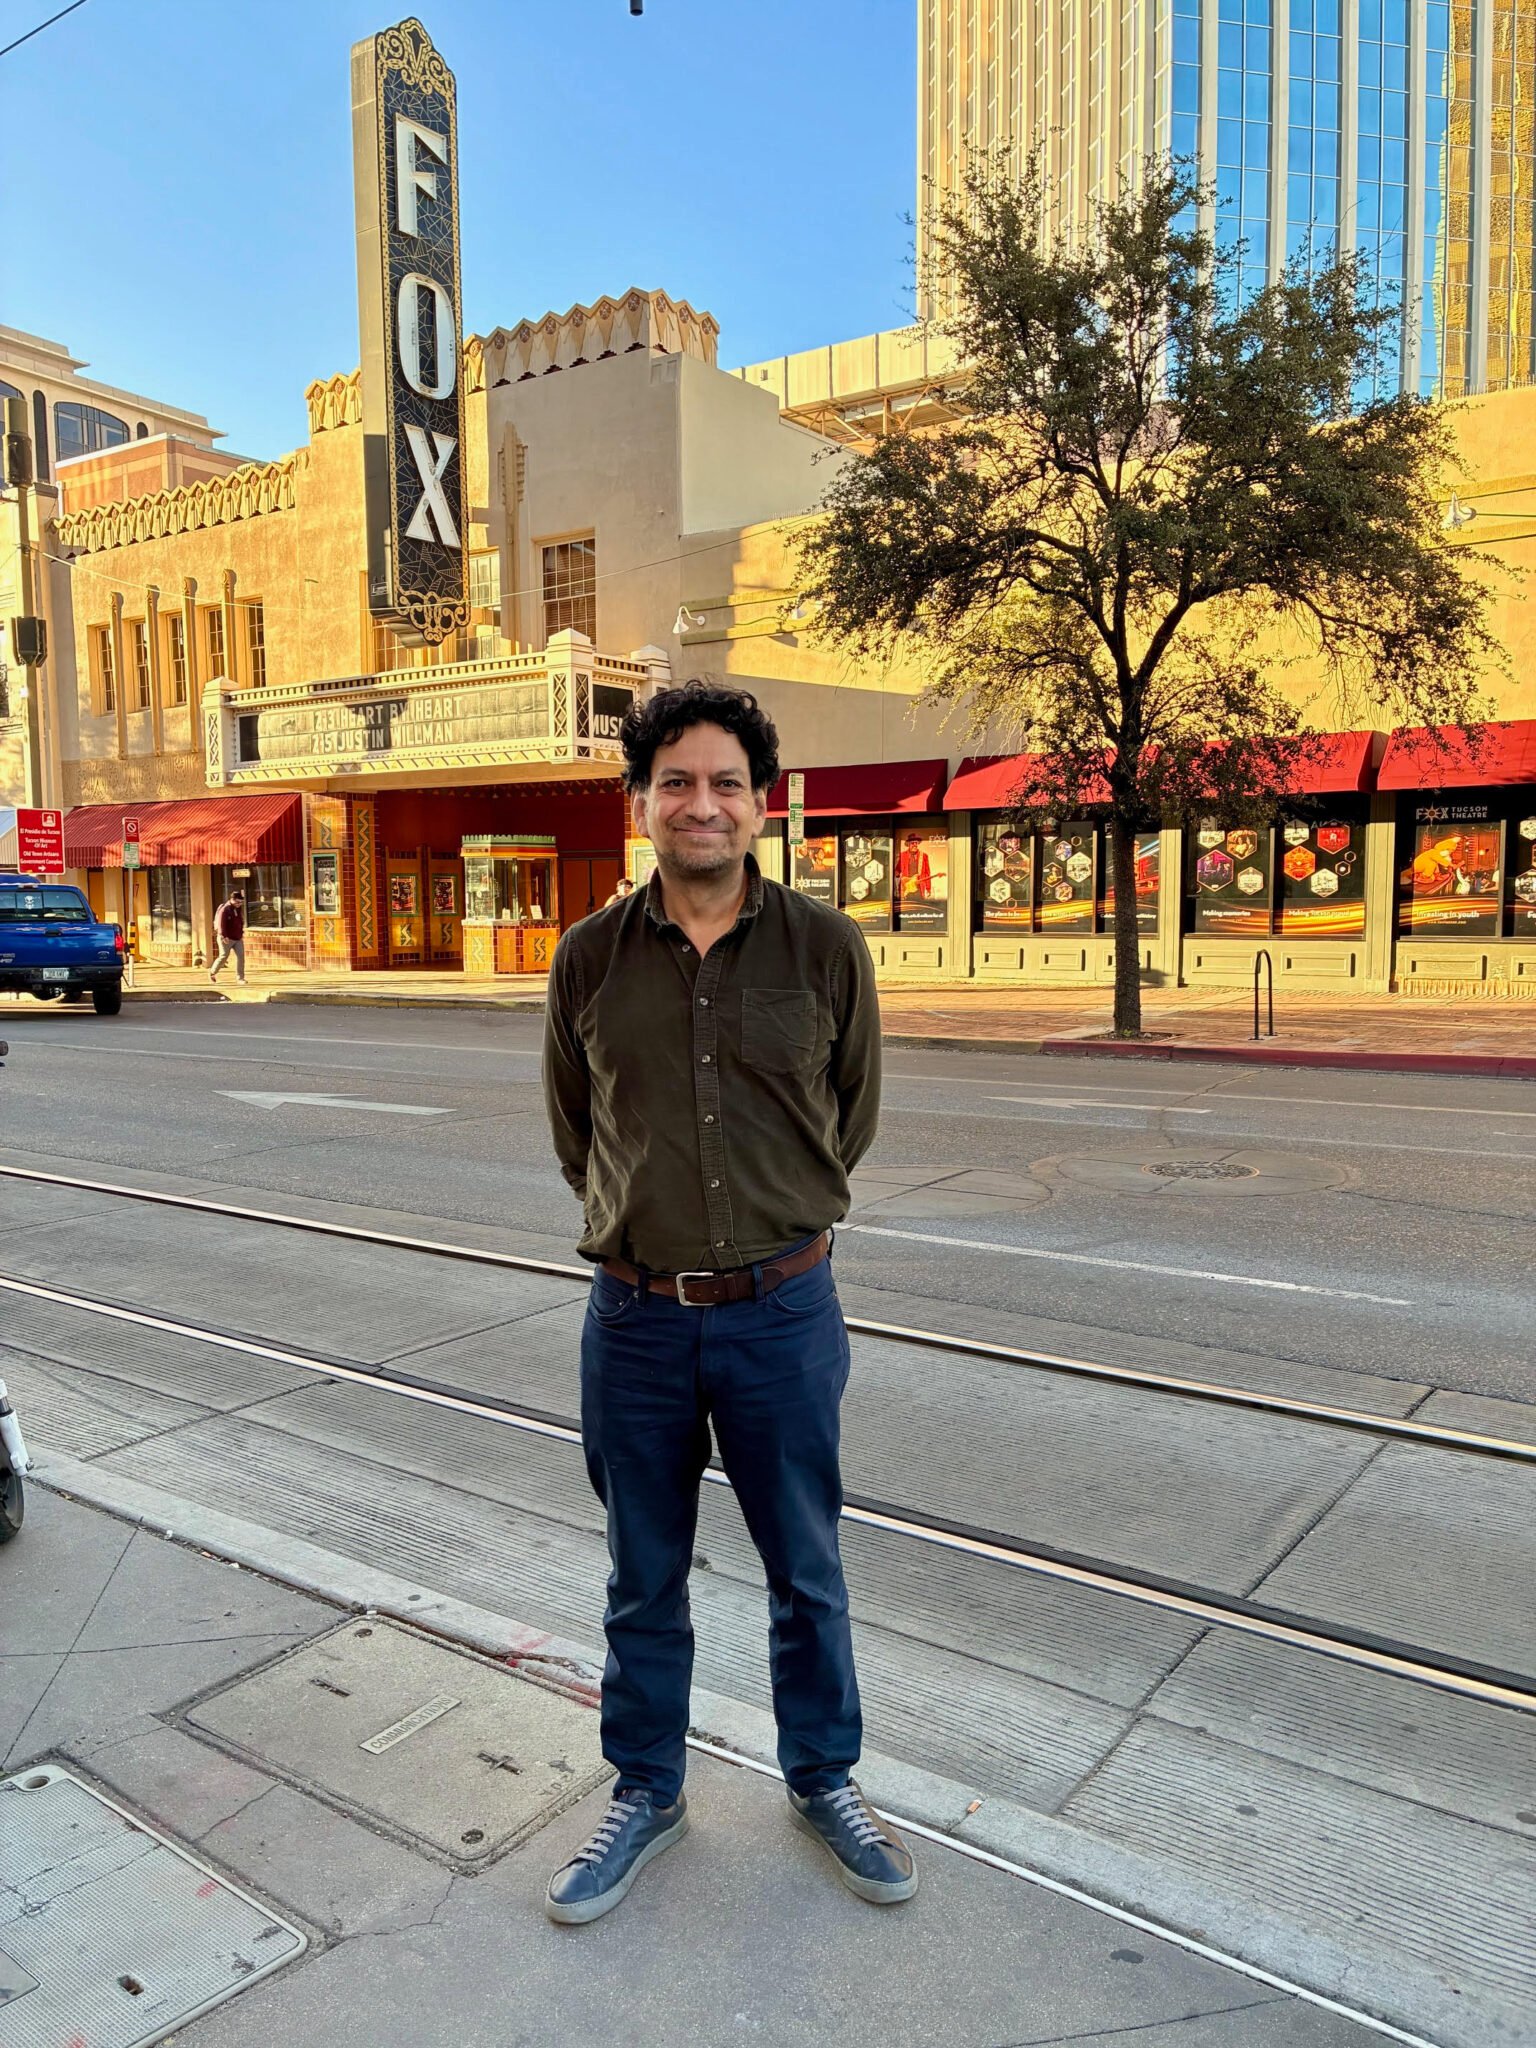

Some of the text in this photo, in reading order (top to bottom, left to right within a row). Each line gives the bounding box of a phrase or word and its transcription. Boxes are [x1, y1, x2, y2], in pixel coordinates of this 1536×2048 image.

[394, 112, 459, 549] FOX
[340, 704, 384, 727] HEART
[390, 702, 407, 724] BY
[416, 696, 463, 719] HEART
[338, 729, 384, 751] JUSTIN
[391, 720, 453, 747] WILLMAN
[1457, 909, 1480, 919] youth
[369, 1696, 452, 1750] COMMUNICATIONS
